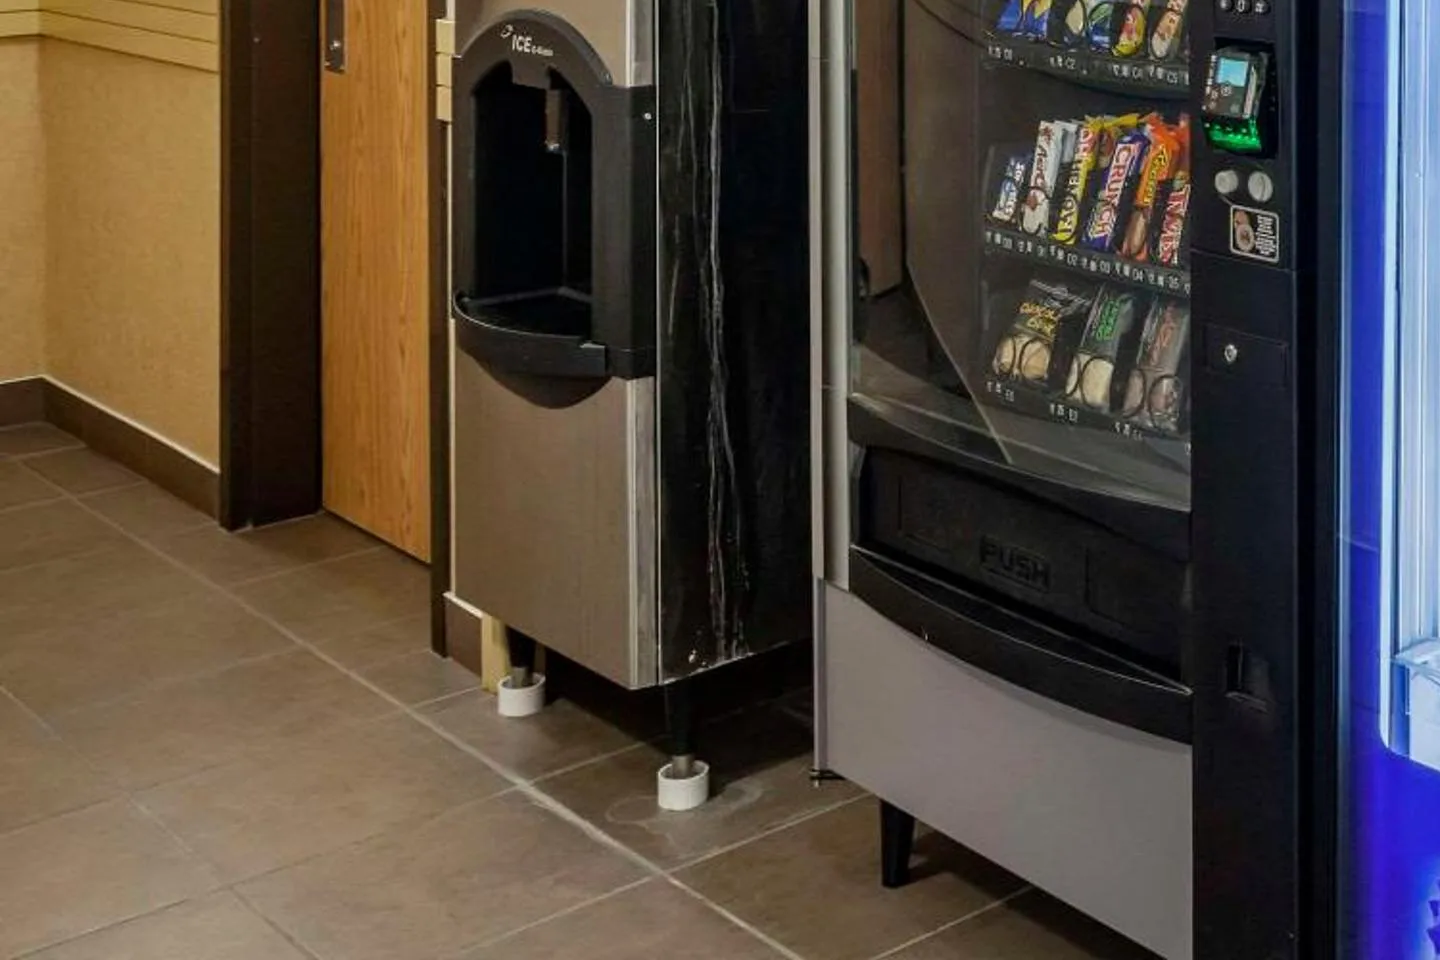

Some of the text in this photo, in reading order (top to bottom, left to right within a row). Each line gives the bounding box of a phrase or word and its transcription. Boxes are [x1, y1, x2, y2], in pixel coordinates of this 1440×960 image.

[512, 34, 533, 53] ICE
[1090, 145, 1132, 236] CRUNCH
[979, 536, 1049, 588] PUSH
